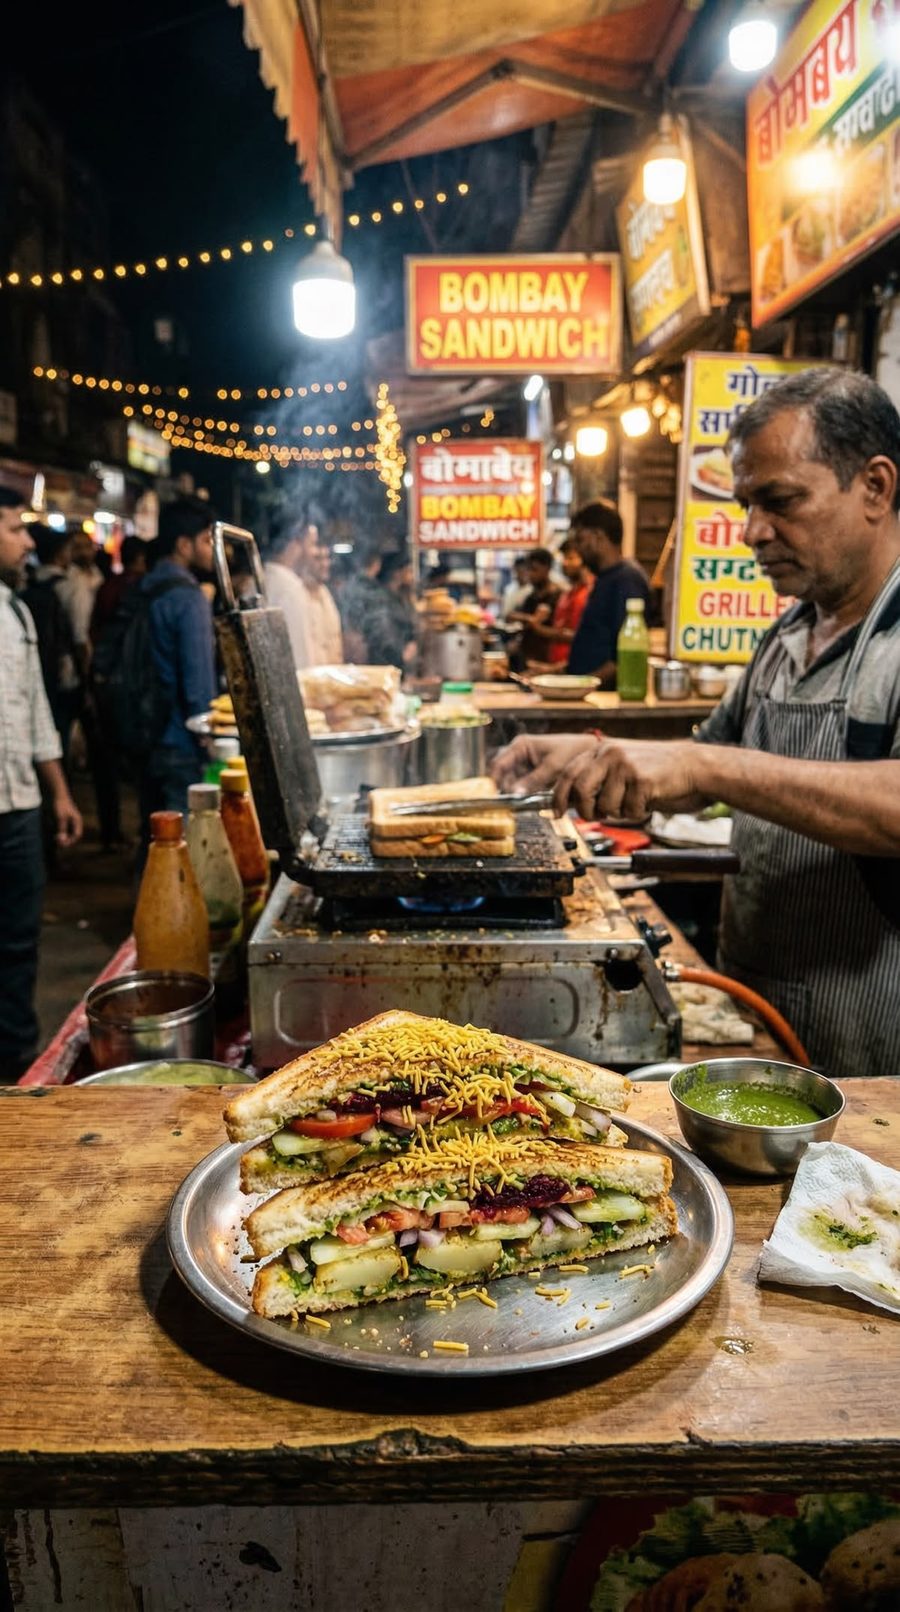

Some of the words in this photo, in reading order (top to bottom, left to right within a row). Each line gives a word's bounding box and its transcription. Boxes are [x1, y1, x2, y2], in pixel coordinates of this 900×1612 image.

[439, 271, 588, 314] BOMBAY
[420, 317, 609, 360] SANDWICH
[421, 494, 535, 519] BOMBAY
[419, 520, 539, 542] SANDWICH
[699, 592, 797, 617] GRILLE
[682, 626, 768, 651] CHUTN
